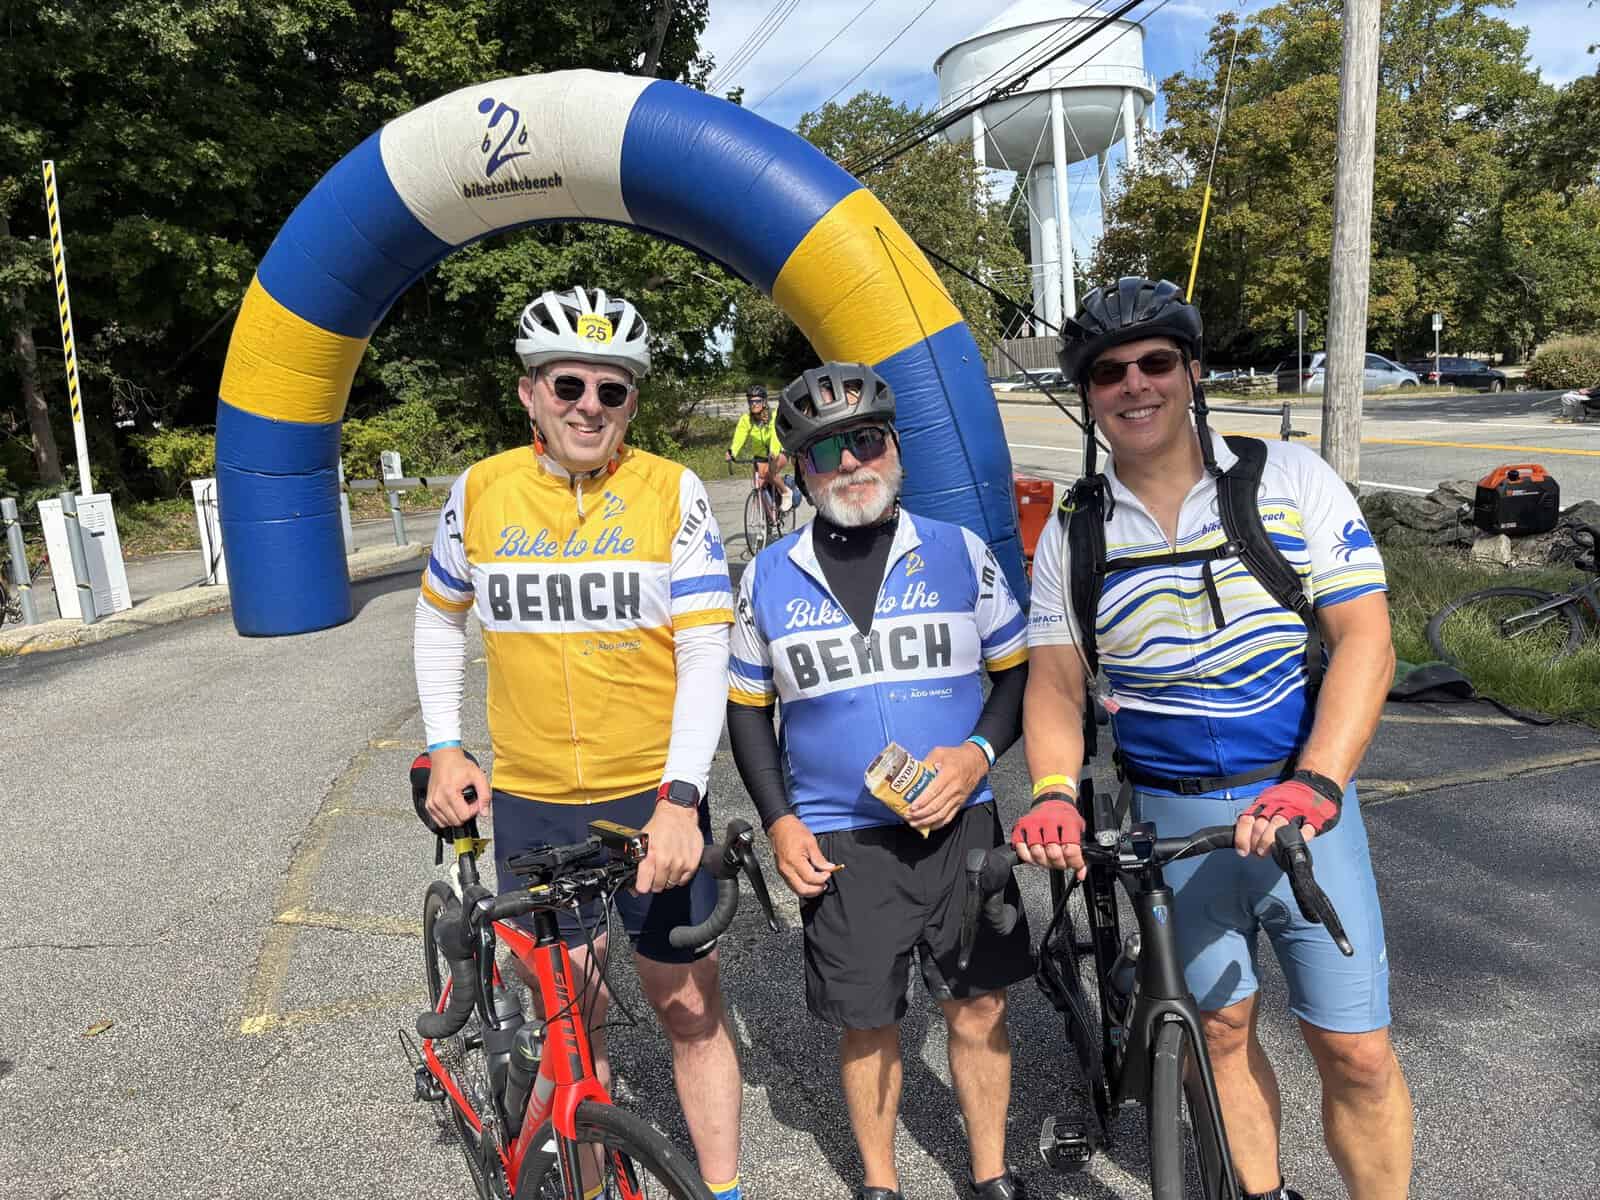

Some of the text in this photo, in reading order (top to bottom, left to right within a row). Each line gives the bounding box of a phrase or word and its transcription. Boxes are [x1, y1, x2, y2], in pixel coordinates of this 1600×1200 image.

[463, 171, 563, 198] biketothebeach
[585, 324, 607, 341] 25
[495, 525, 635, 557] Bike to the
[488, 571, 641, 621] BEACH
[902, 581, 941, 609] the
[786, 623, 952, 690] BEACH
